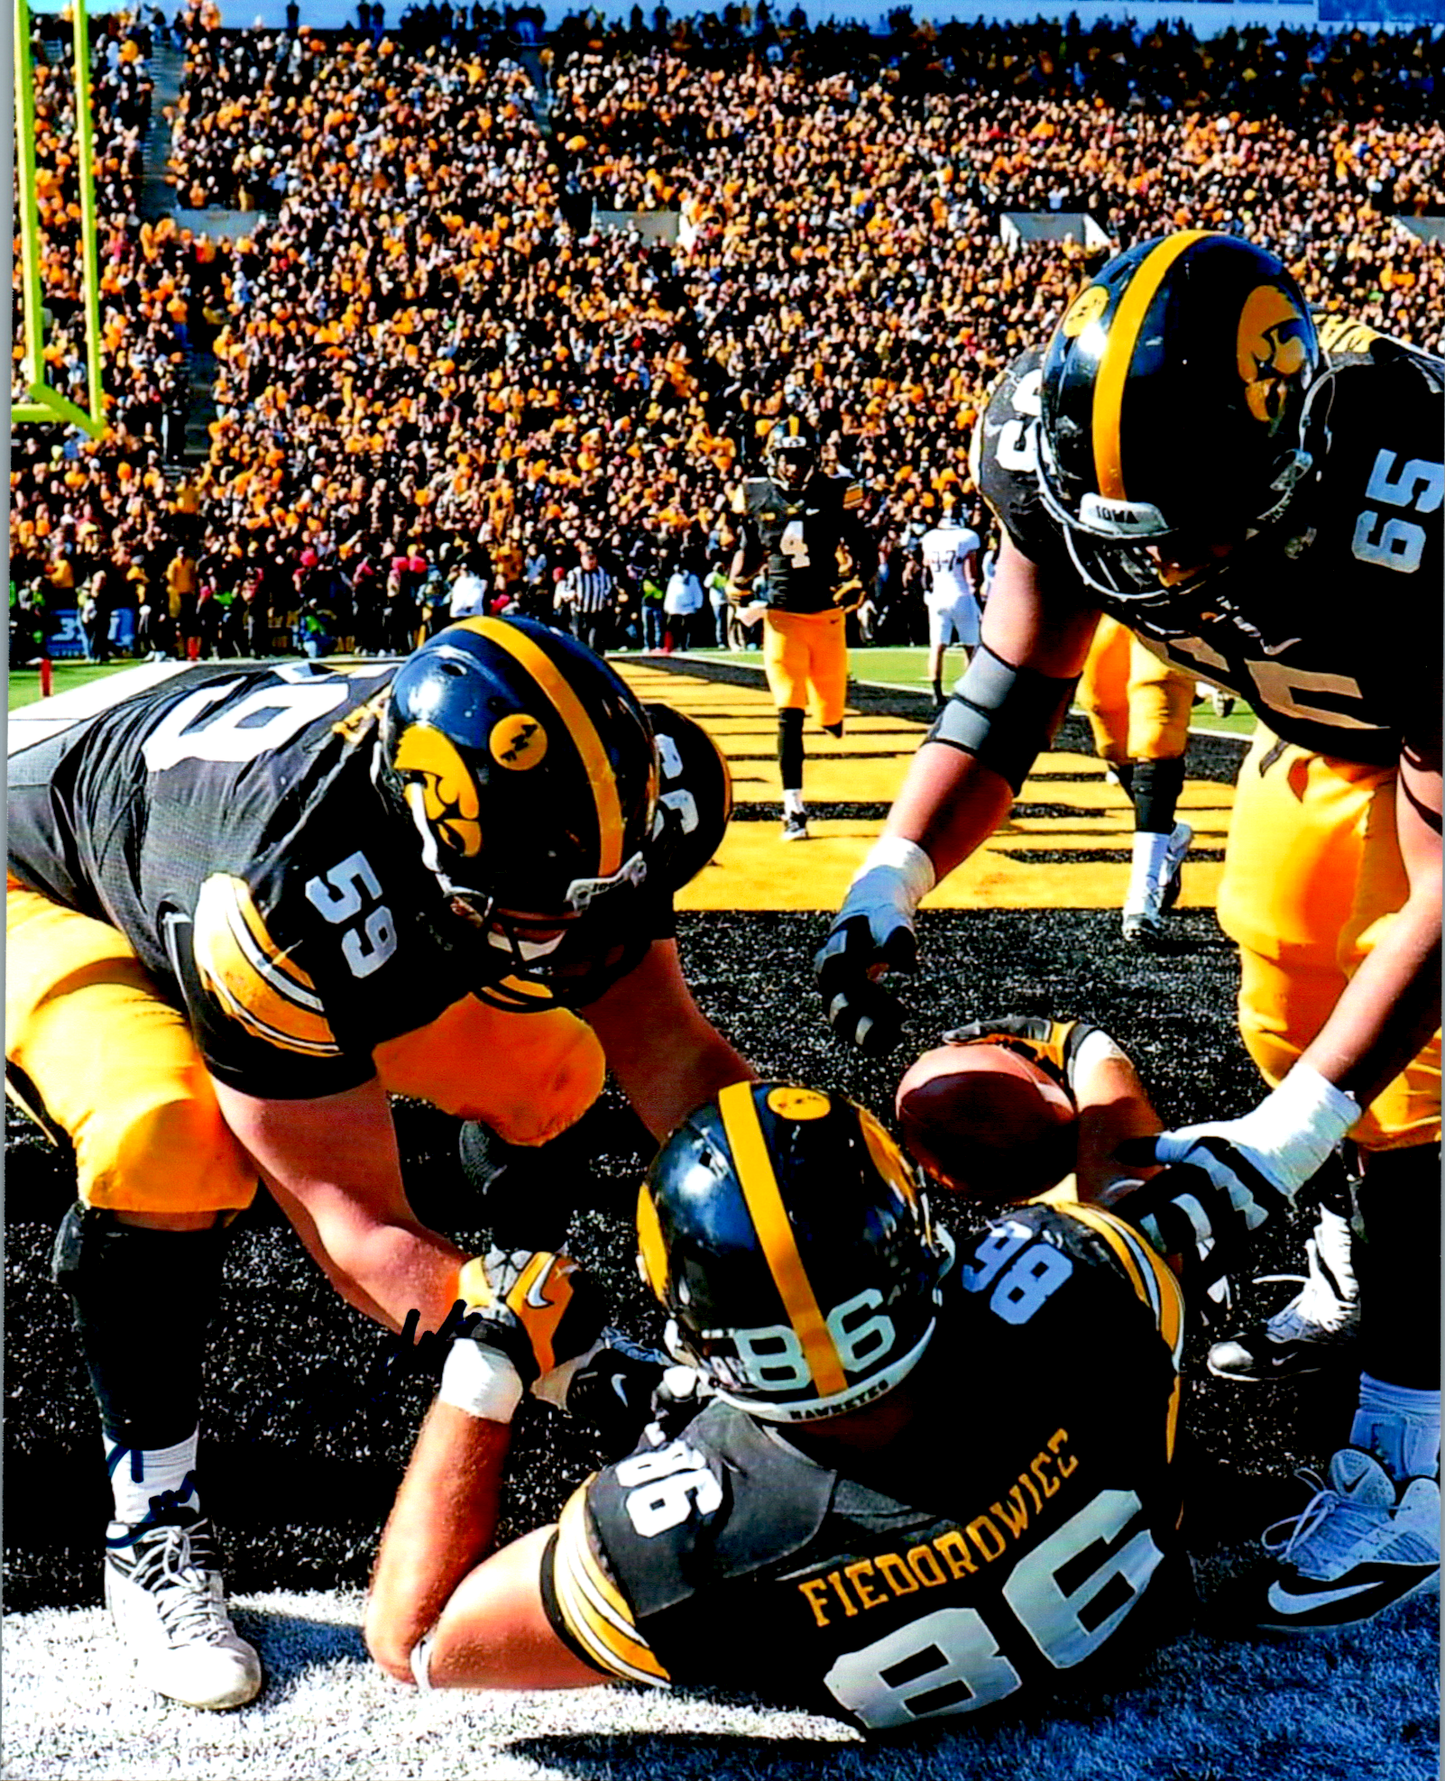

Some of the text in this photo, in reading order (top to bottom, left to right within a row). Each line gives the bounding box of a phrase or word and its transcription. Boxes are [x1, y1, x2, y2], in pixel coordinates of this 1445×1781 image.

[780, 521, 811, 568] 4
[1096, 505, 1139, 524] IOWA
[1352, 448, 1444, 573] 65
[305, 851, 398, 978] 59
[735, 1288, 896, 1391] 86
[799, 1428, 1079, 1627] FIEDOROWICZ
[824, 1489, 1165, 1729] 86
